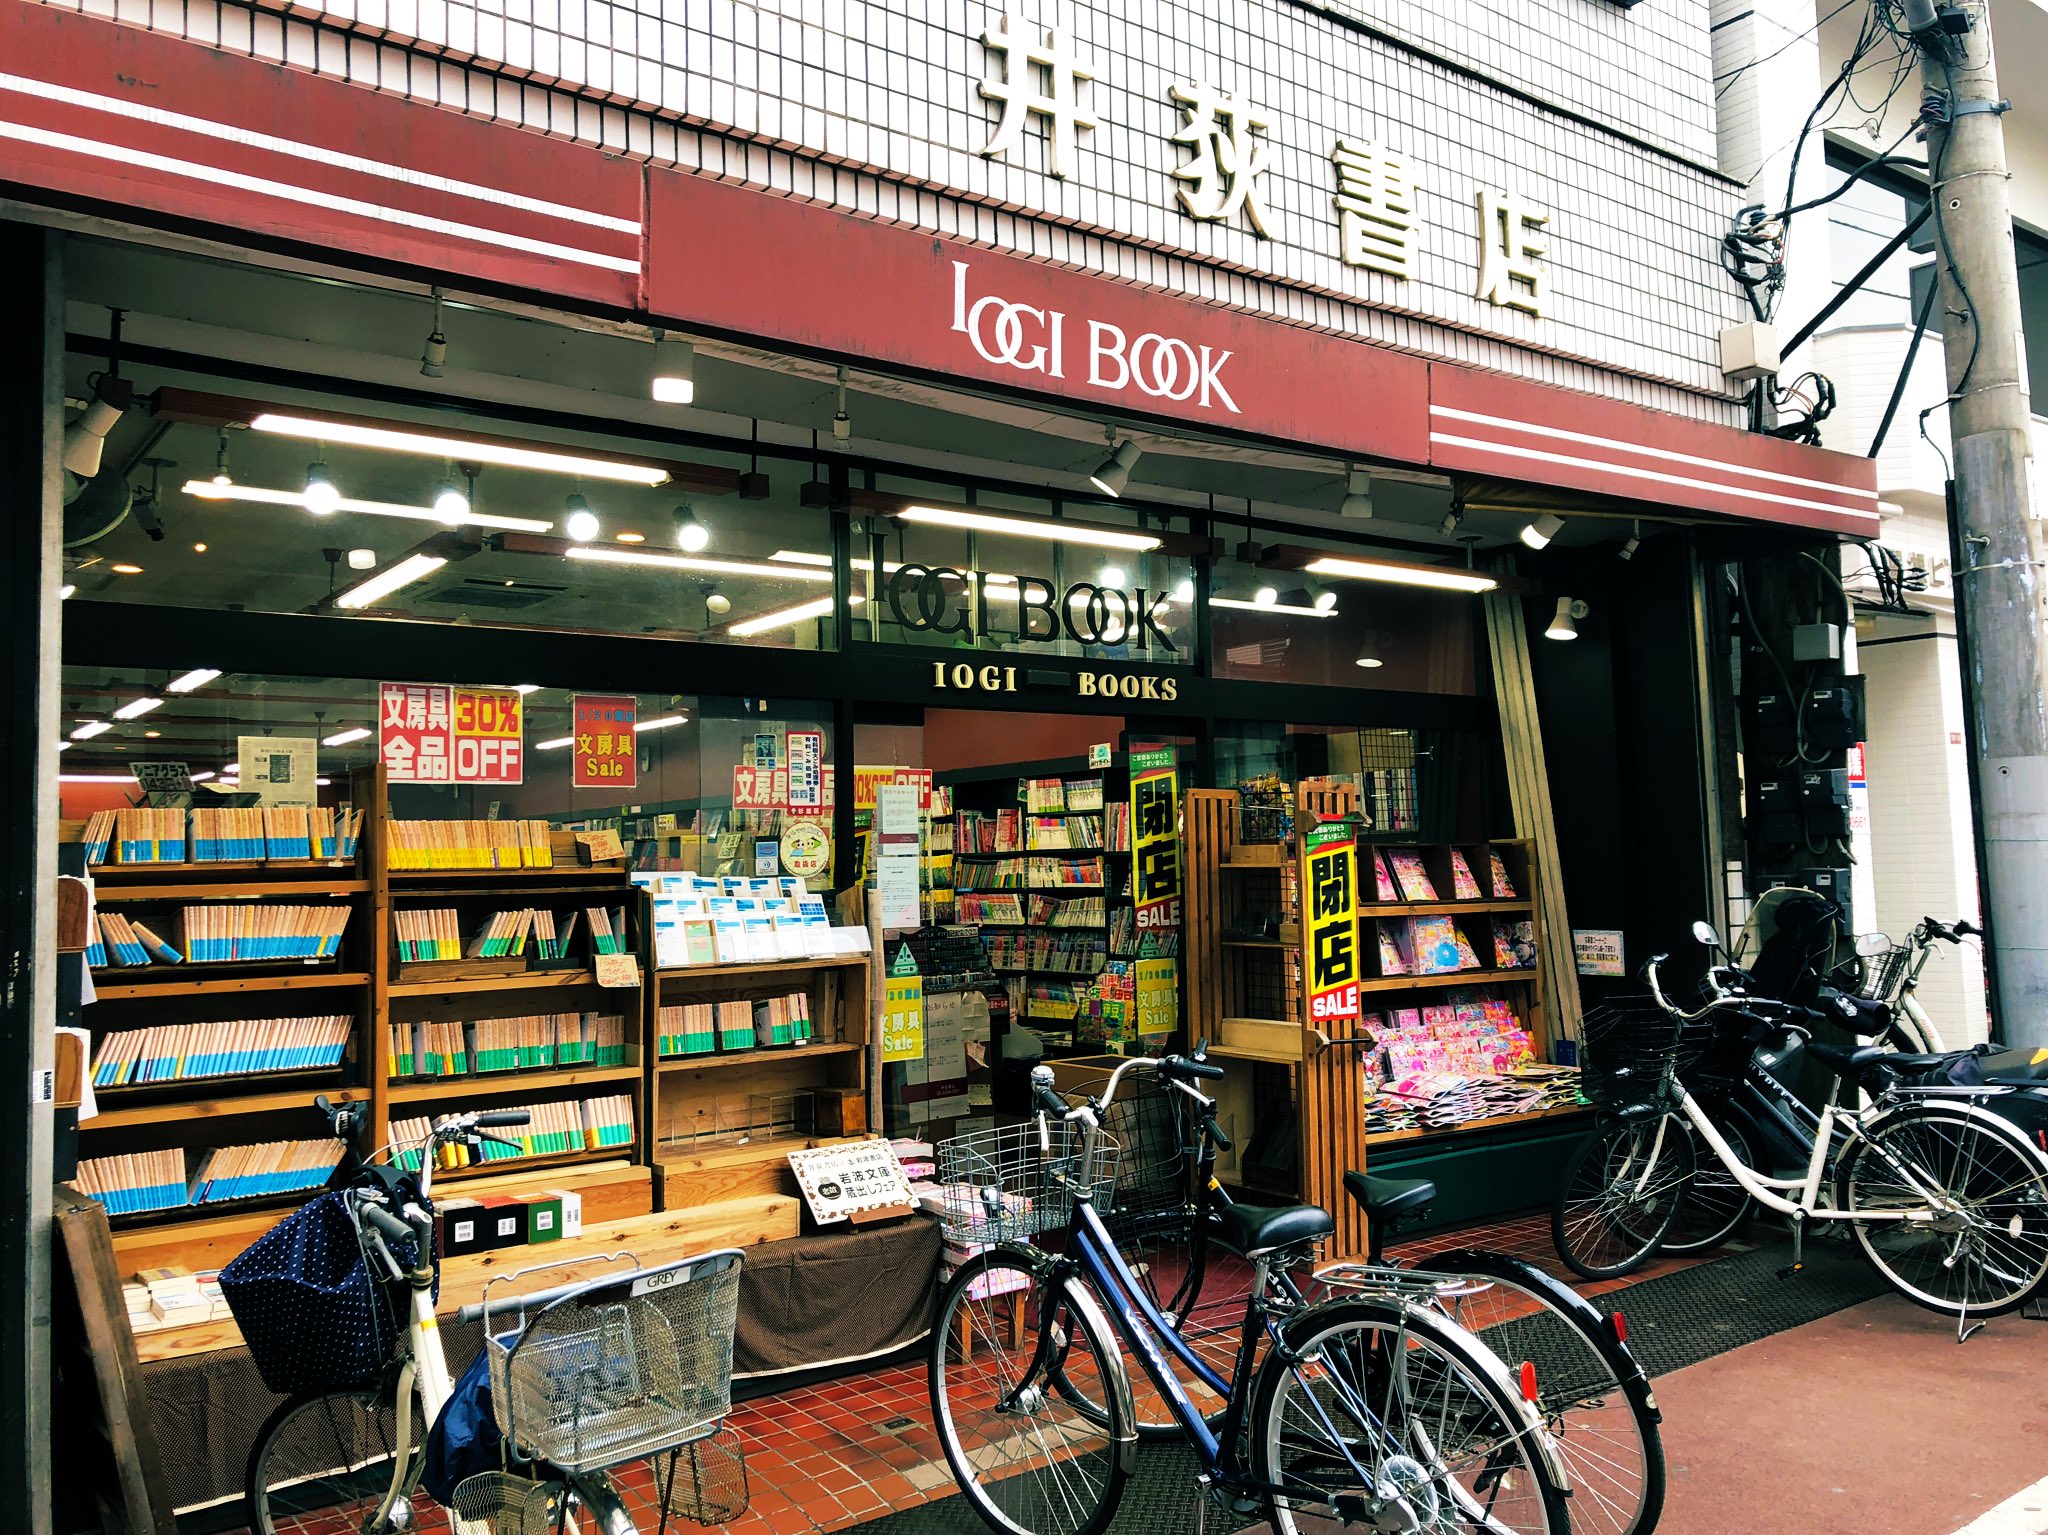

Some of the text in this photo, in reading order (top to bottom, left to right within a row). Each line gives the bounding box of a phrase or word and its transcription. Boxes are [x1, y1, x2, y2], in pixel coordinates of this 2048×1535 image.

[976, 12, 1551, 319] 井荻書店
[950, 260, 1243, 414] IOGI BOOK
[871, 532, 1181, 652] IOGI BOOK
[933, 662, 1178, 701] IOGI BOOKS
[383, 686, 449, 731] 文房具
[457, 693, 519, 733] 30%
[383, 735, 449, 780] 全品
[457, 739, 520, 778] OFF
[576, 733, 633, 756] 文房具
[586, 757, 624, 778] Sale
[1135, 776, 1177, 903] 閉店
[1136, 900, 1180, 929] SALE
[1311, 850, 1353, 991] 閉店
[1138, 988, 1174, 1009] 文房具
[1312, 985, 1358, 1018] SALE
[1145, 1009, 1170, 1026] Sale
[883, 1033, 913, 1053] Sale
[839, 1166, 892, 1184] 岩波文庫
[844, 1180, 896, 1199] 蔵出しフェア
[647, 1270, 678, 1288] GREY
